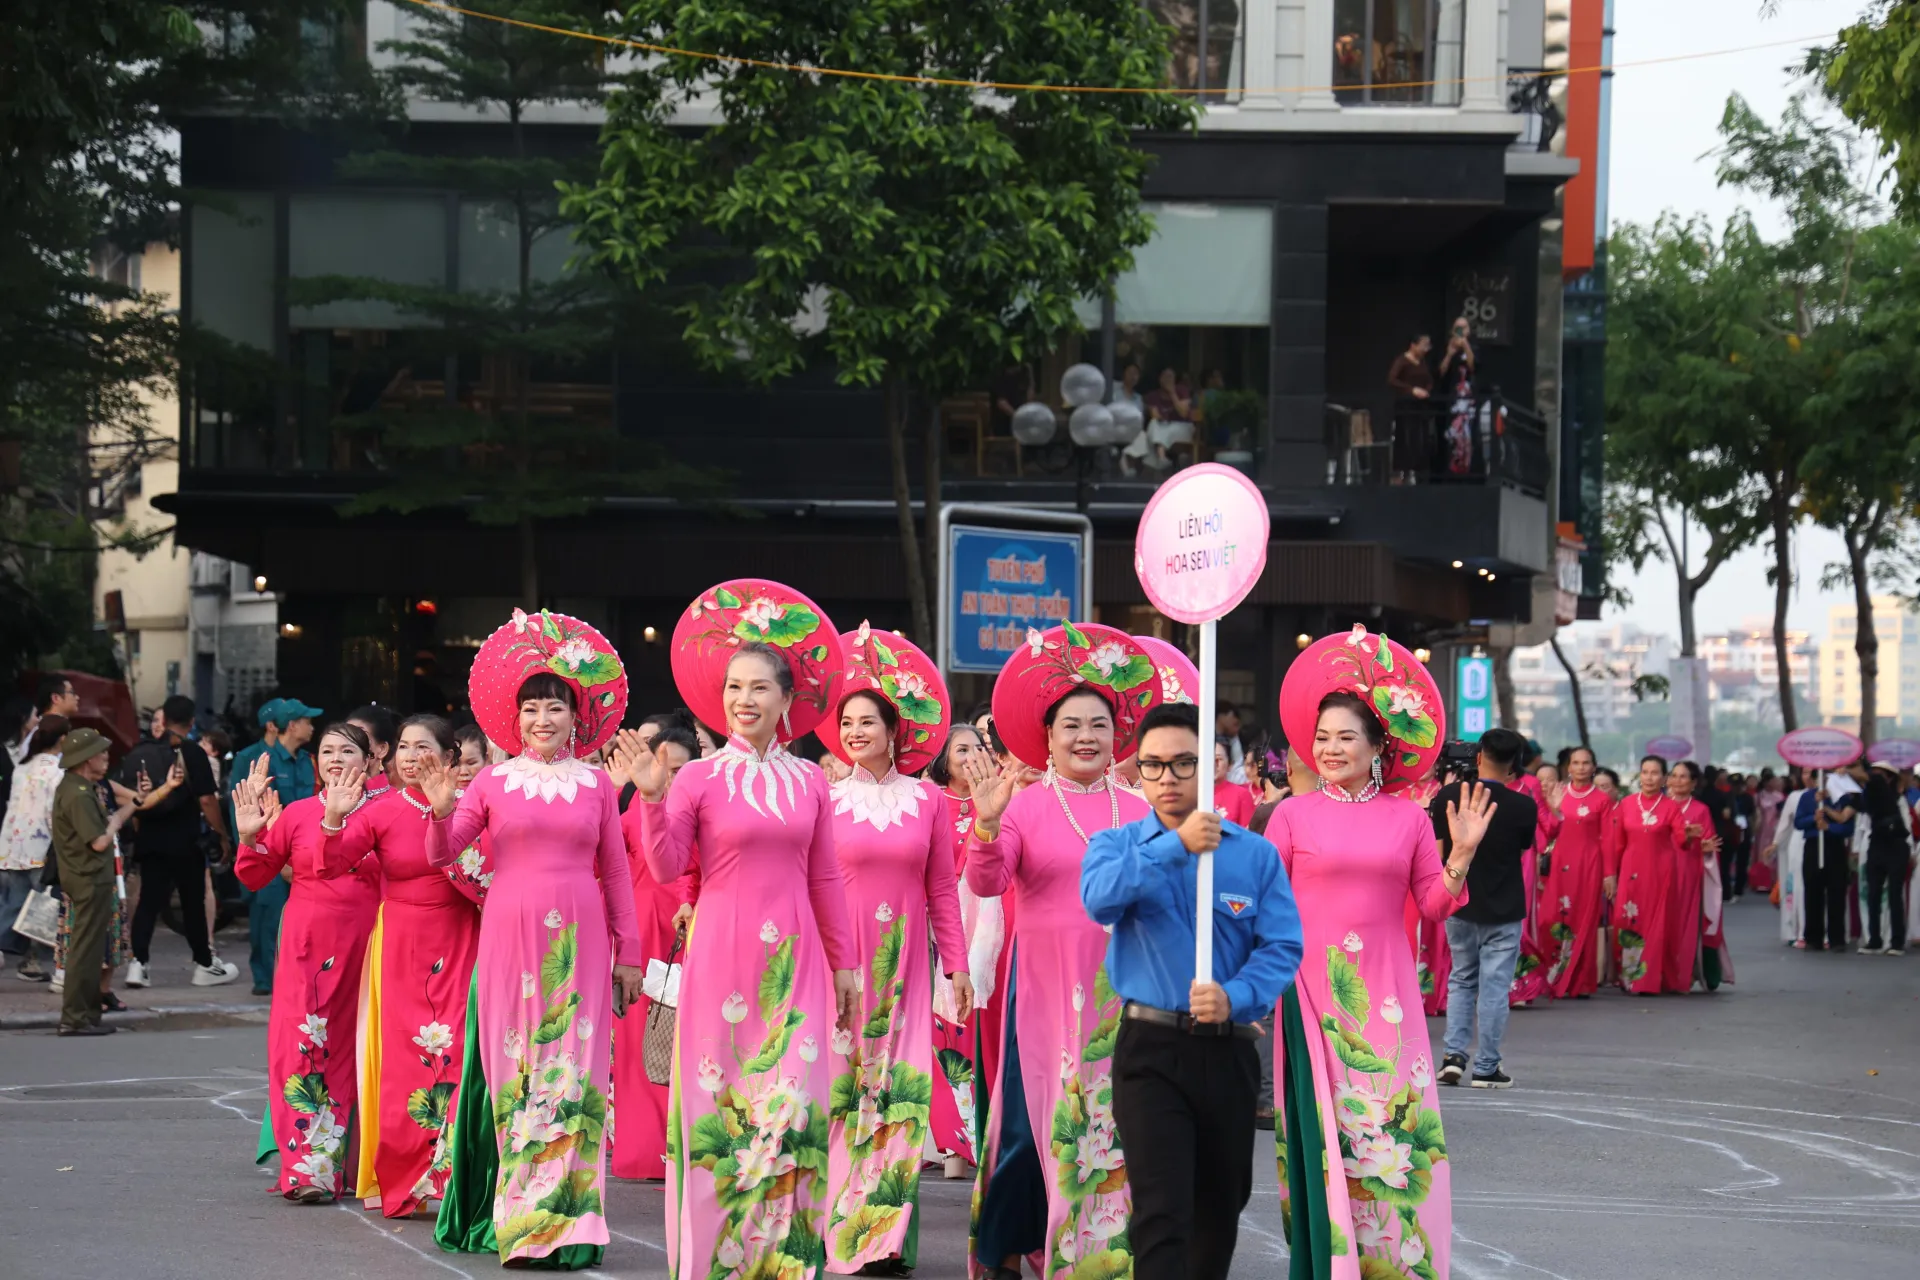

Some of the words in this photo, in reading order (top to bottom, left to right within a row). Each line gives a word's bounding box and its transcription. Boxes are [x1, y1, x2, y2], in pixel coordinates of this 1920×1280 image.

[1463, 296, 1497, 321] 86
[1178, 512, 1202, 539] LIÊN
[1165, 552, 1189, 575] HOA
[1190, 549, 1211, 571] SEN
[1213, 540, 1237, 570] VIỆT
[960, 591, 978, 615] AN
[979, 587, 1008, 616] TOÀN
